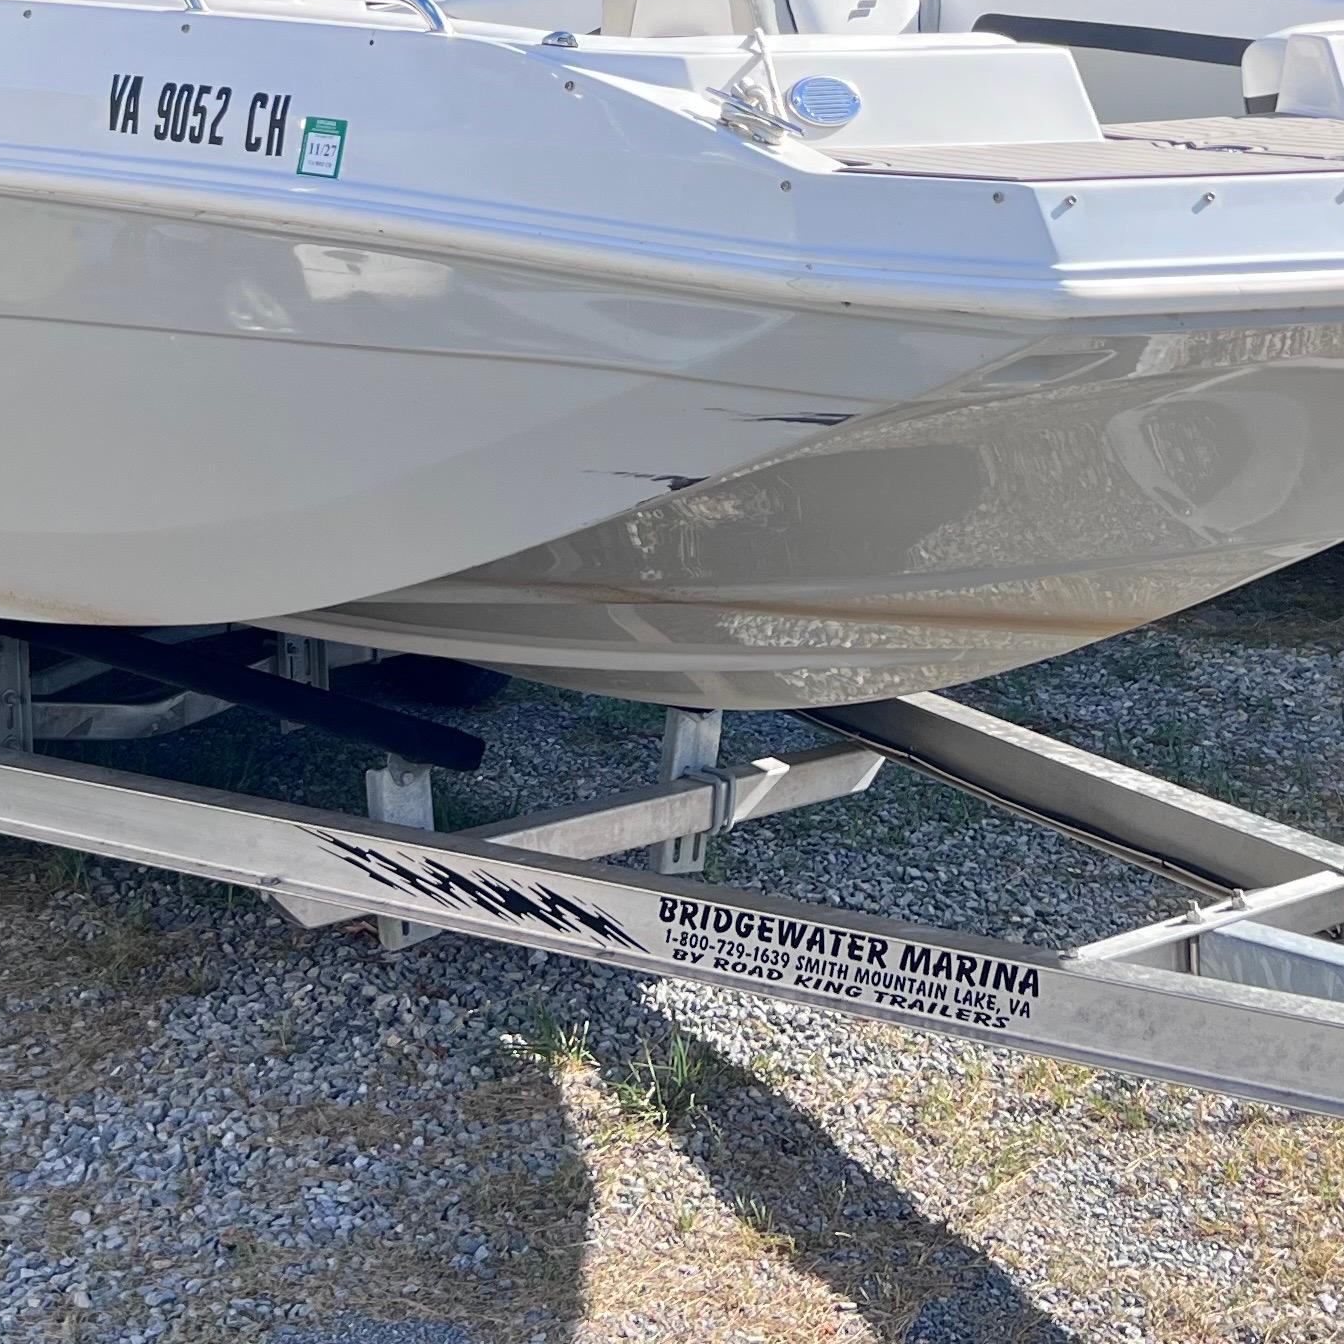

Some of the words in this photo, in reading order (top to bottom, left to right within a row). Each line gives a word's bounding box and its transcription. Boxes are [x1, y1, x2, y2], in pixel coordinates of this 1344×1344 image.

[109, 73, 144, 135] VA
[154, 82, 233, 146] 9052
[244, 91, 292, 157] CH
[309, 142, 337, 157] 11/27
[659, 896, 889, 969] BRIDGEWATER
[899, 944, 1039, 998] MARINA
[665, 928, 790, 969] 1-800-729-1639
[795, 955, 849, 981] SMITH
[854, 967, 947, 1001] MOUNTAIN
[954, 987, 1001, 1015] LAKE,
[1009, 997, 1031, 1019] VA
[672, 948, 705, 964] BY
[713, 956, 784, 981] ROAD
[793, 974, 863, 998] KING
[874, 990, 1010, 1029] TRAILERS
